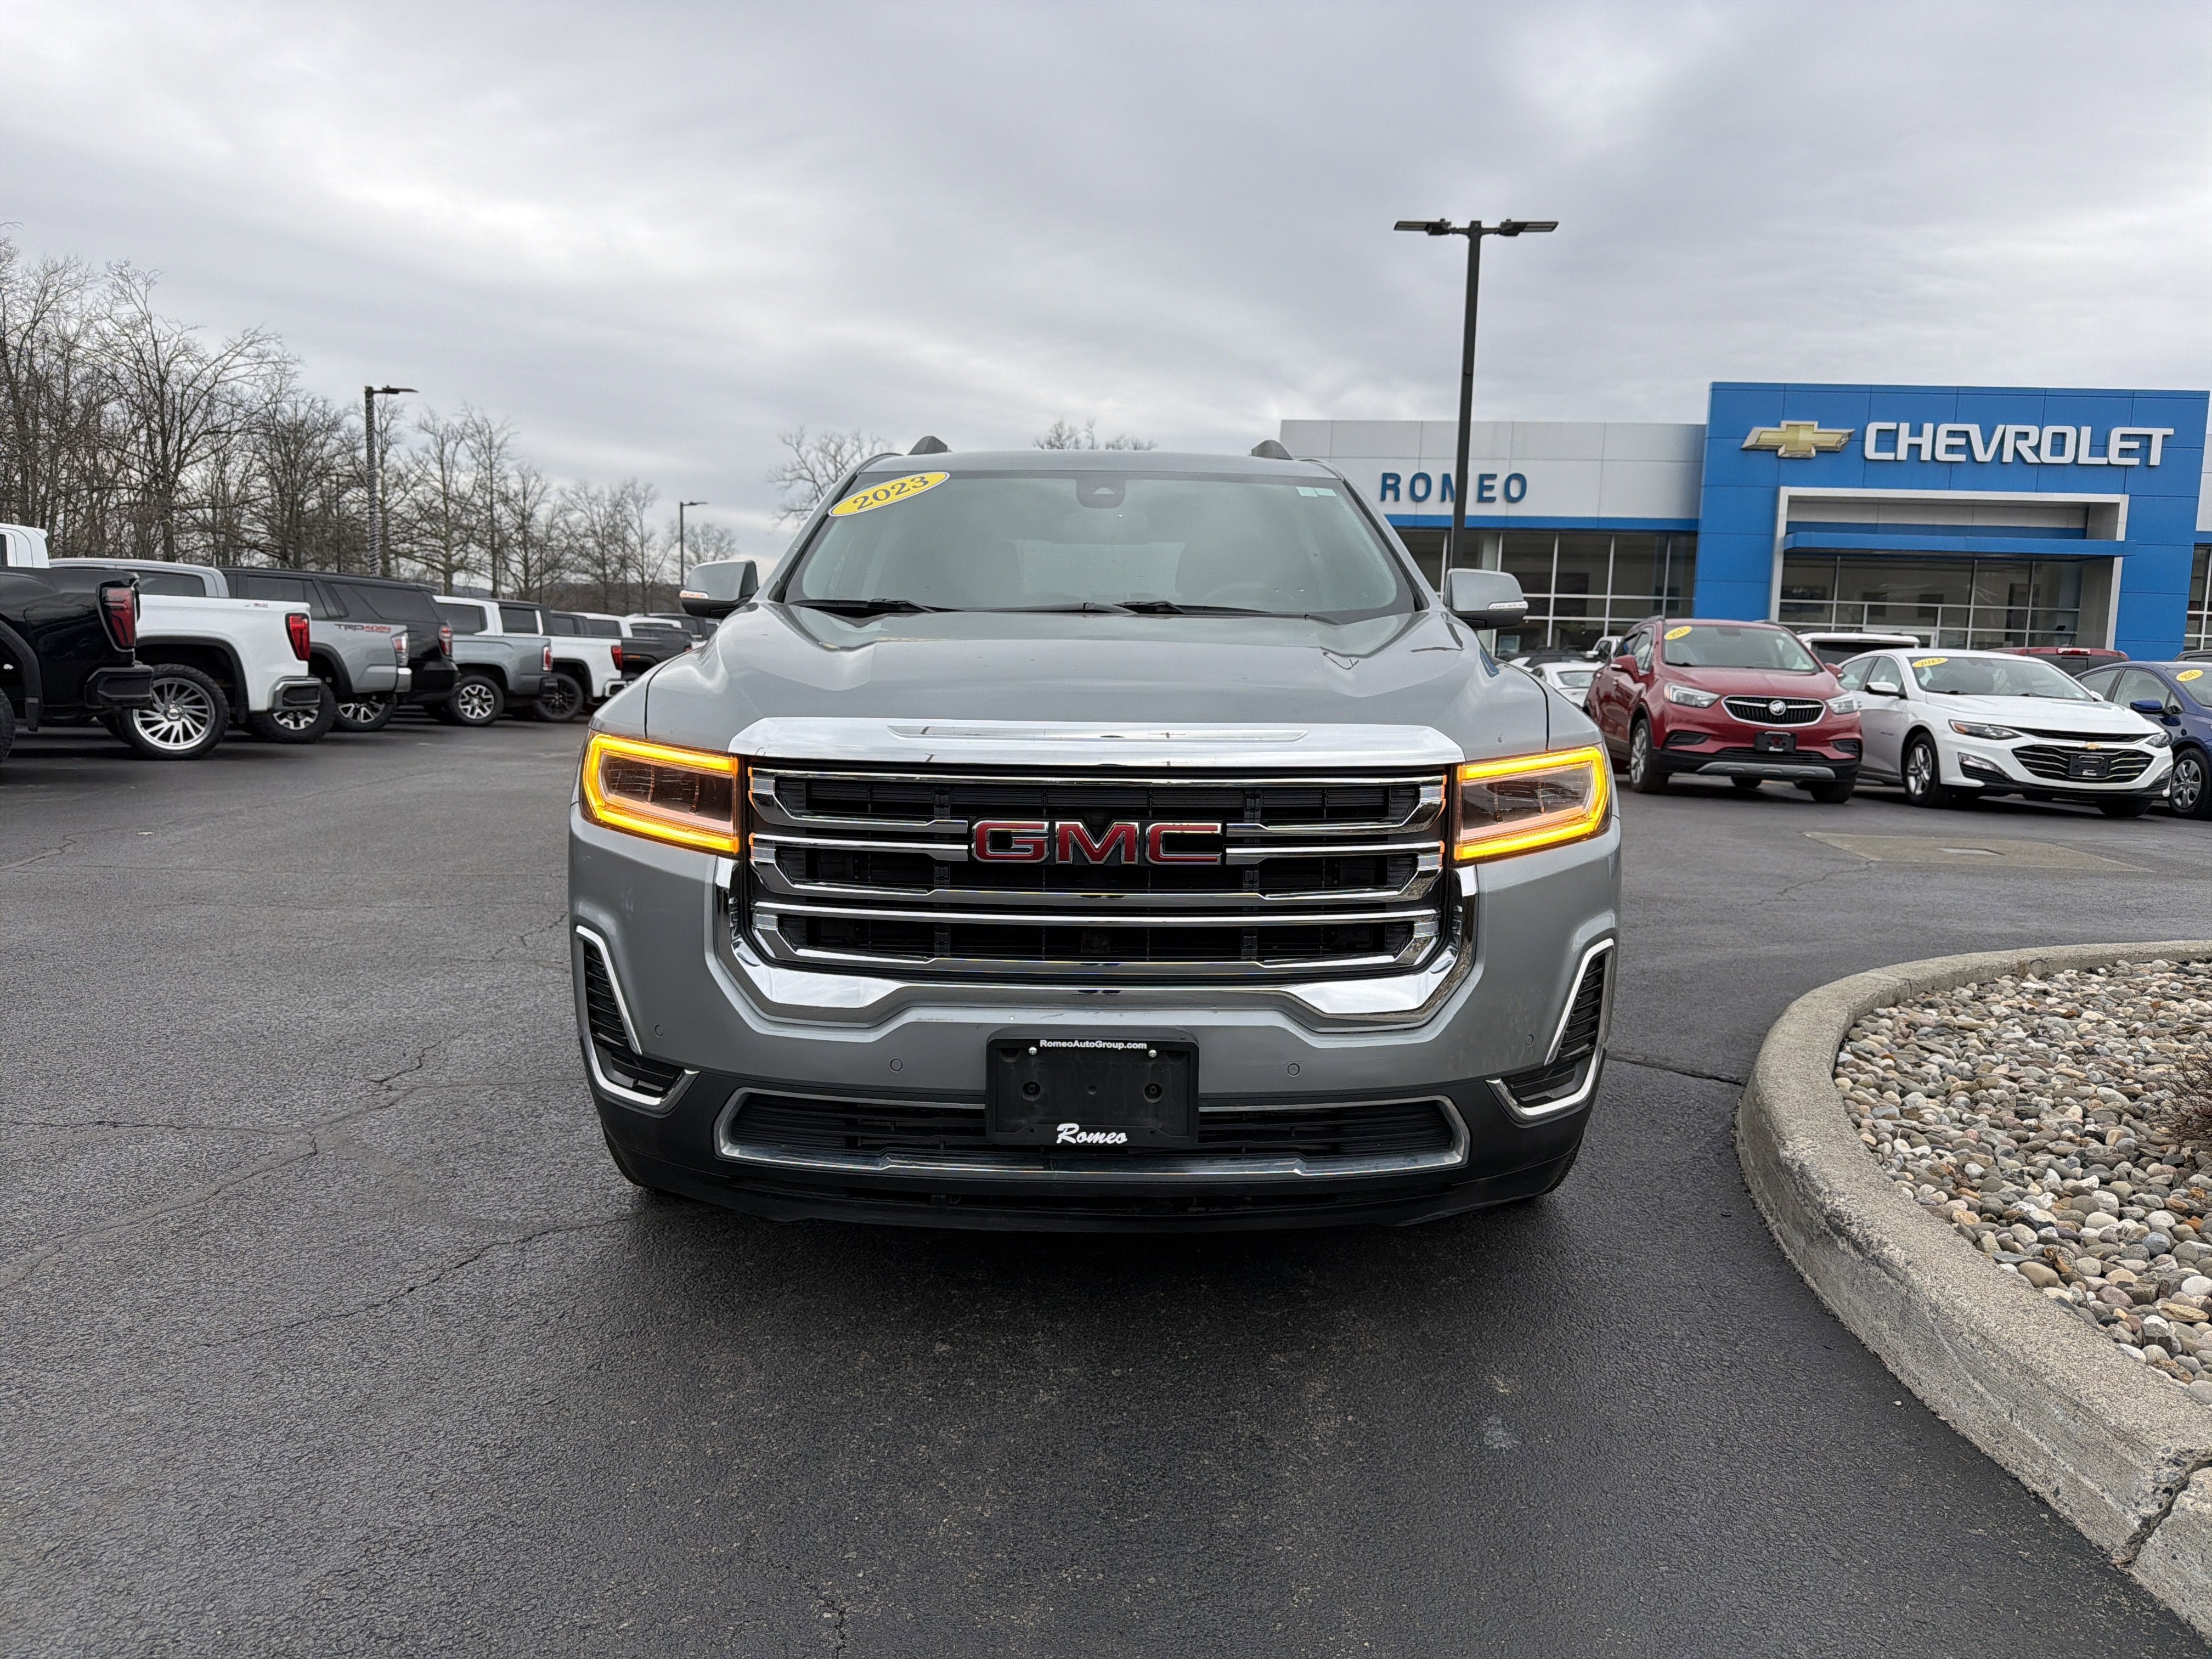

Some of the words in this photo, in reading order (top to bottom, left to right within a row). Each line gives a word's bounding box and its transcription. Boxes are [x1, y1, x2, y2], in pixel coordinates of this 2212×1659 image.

[1865, 422, 2174, 466] CHEVROLET
[853, 476, 929, 510] 2023
[971, 820, 1223, 865] GMC
[1040, 1040, 1147, 1050] RomeoAutoGroup.com
[1056, 1123, 1128, 1144] Romeo
